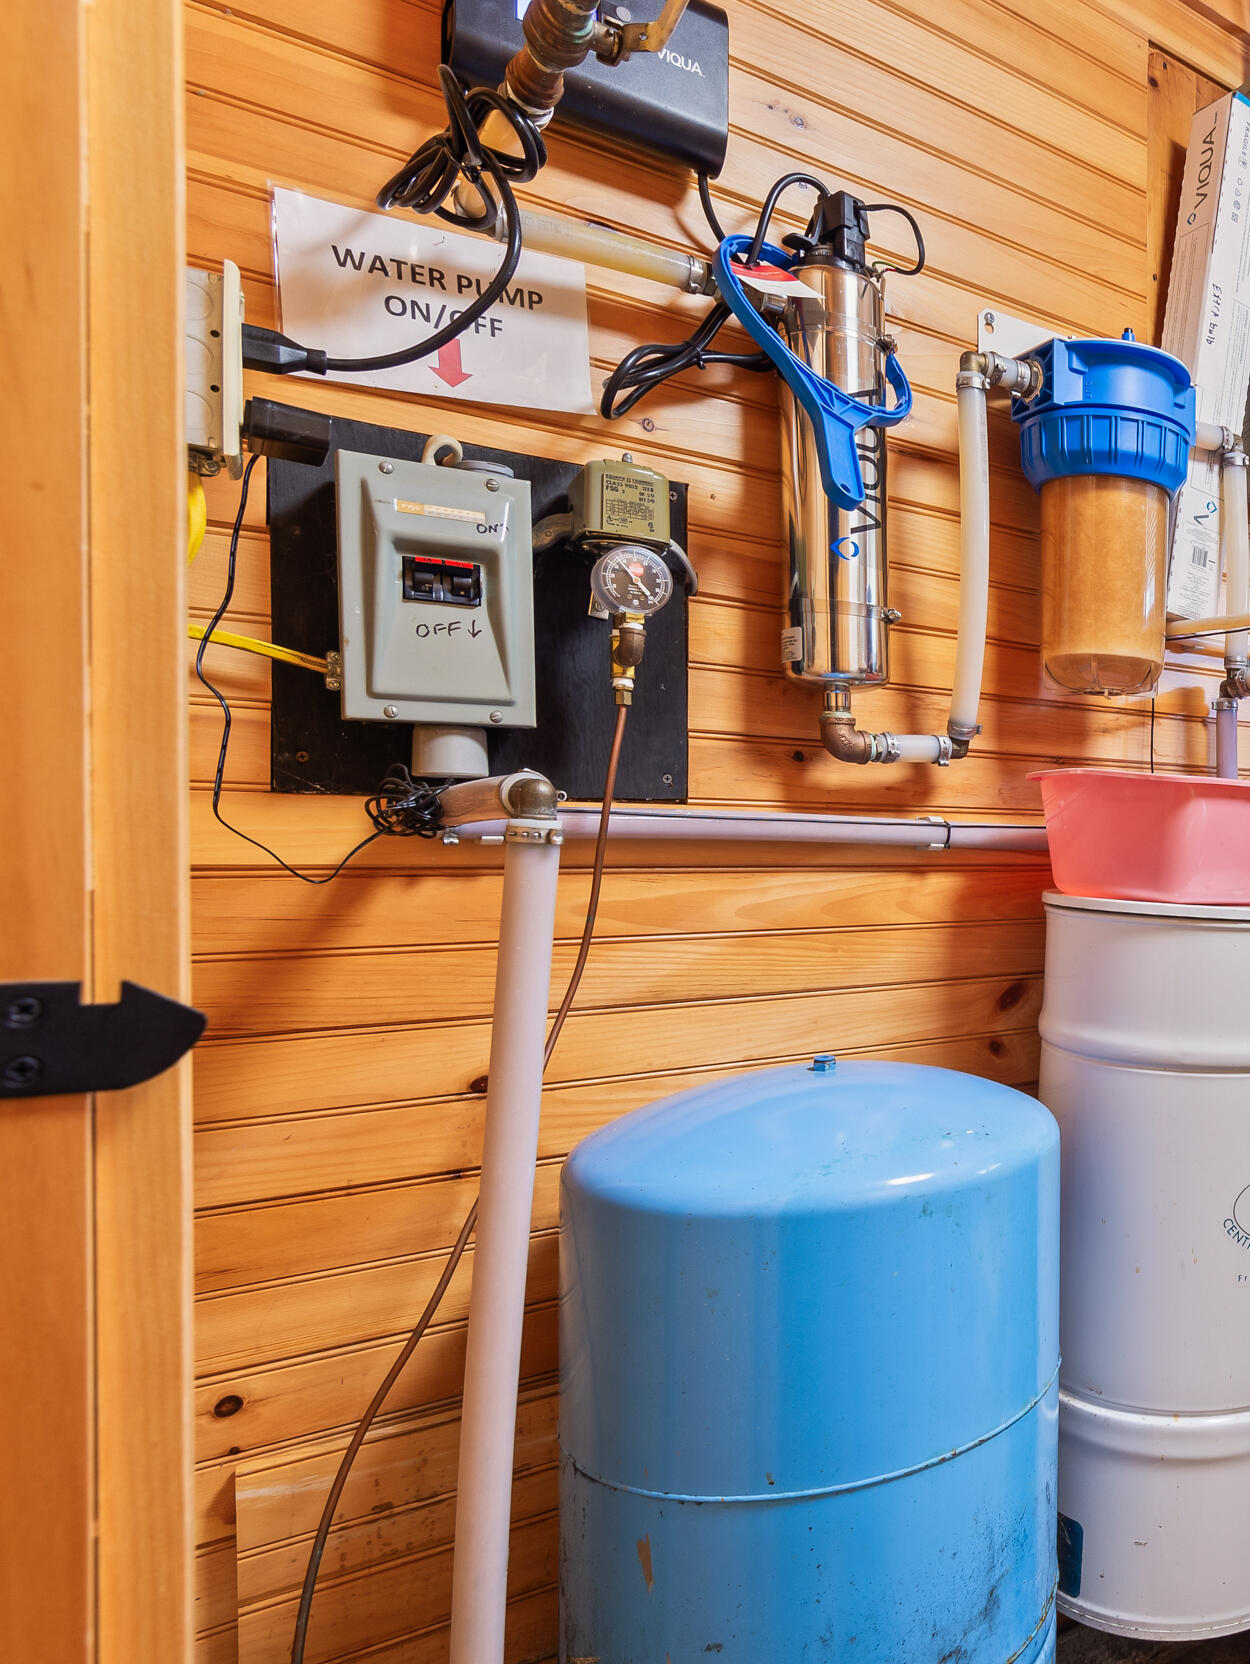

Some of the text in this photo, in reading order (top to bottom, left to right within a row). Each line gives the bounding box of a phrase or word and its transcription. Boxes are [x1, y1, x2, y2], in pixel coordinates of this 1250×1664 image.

[657, 48, 704, 77] VIQUA
[1194, 126, 1217, 210] VIQUA
[331, 246, 544, 311] WATER PUMP
[476, 523, 499, 534] ON
[415, 620, 462, 638] OFF
